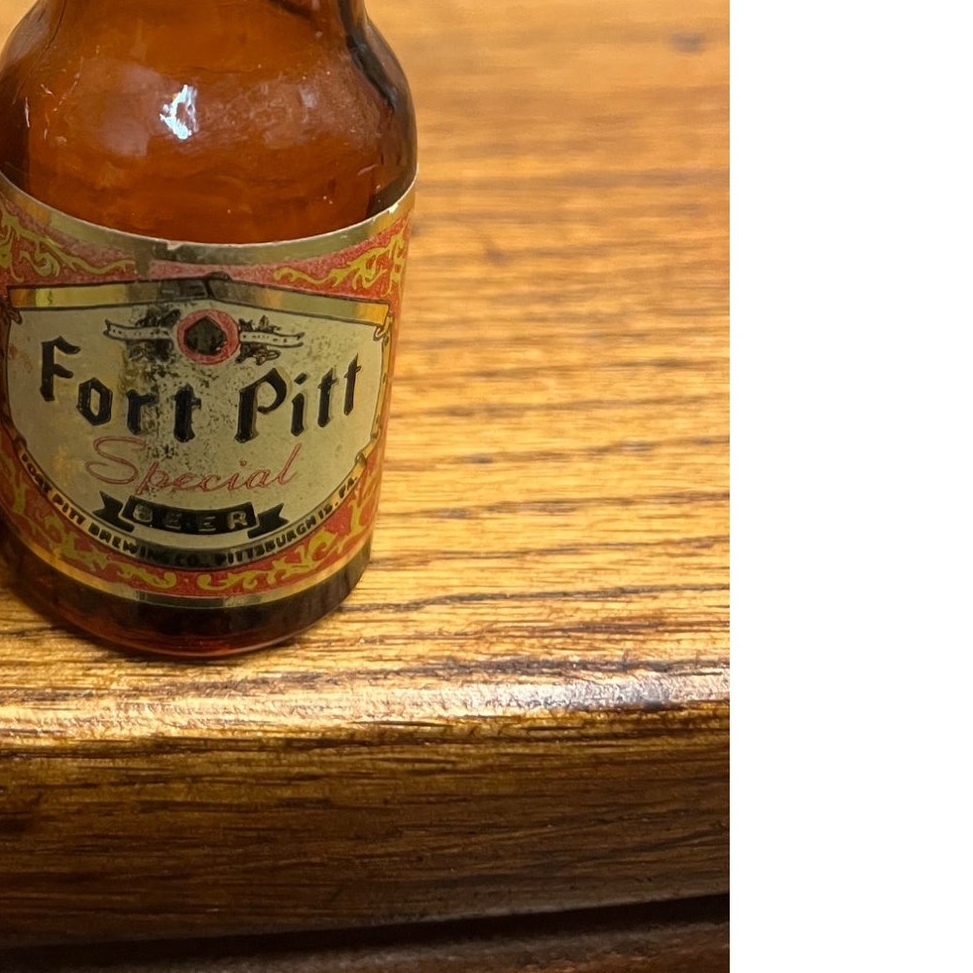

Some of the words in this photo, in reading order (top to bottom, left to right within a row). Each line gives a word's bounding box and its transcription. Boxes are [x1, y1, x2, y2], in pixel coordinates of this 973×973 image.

[39, 336, 202, 443] Fort
[234, 353, 362, 443] Pitt
[85, 436, 302, 496] Special
[51, 493, 87, 525] PITT
[88, 522, 172, 565] BREWING
[214, 514, 317, 566] PITTSBURGH
[132, 503, 248, 532] BEER
